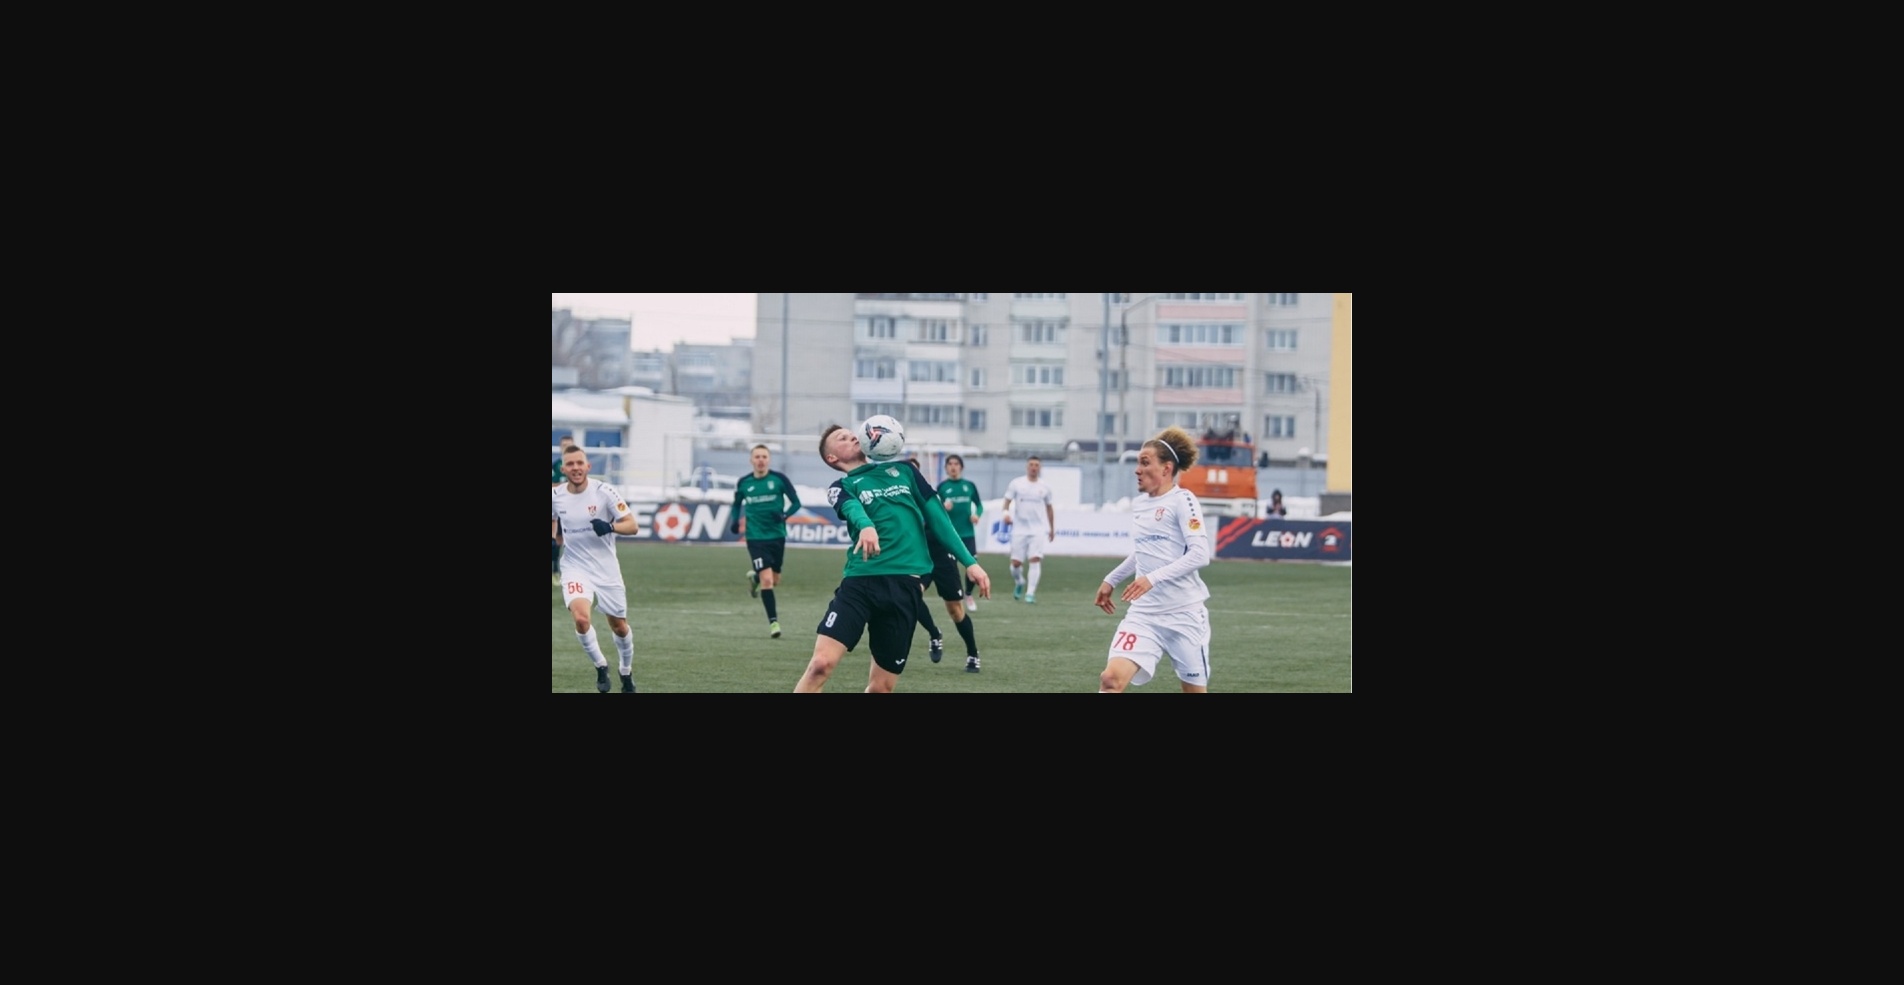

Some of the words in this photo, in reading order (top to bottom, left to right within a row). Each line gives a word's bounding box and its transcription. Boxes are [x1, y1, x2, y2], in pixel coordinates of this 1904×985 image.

[618, 502, 731, 541] EON
[1251, 531, 1313, 548] LEON
[567, 581, 584, 595] 56
[1113, 631, 1137, 651] 78
